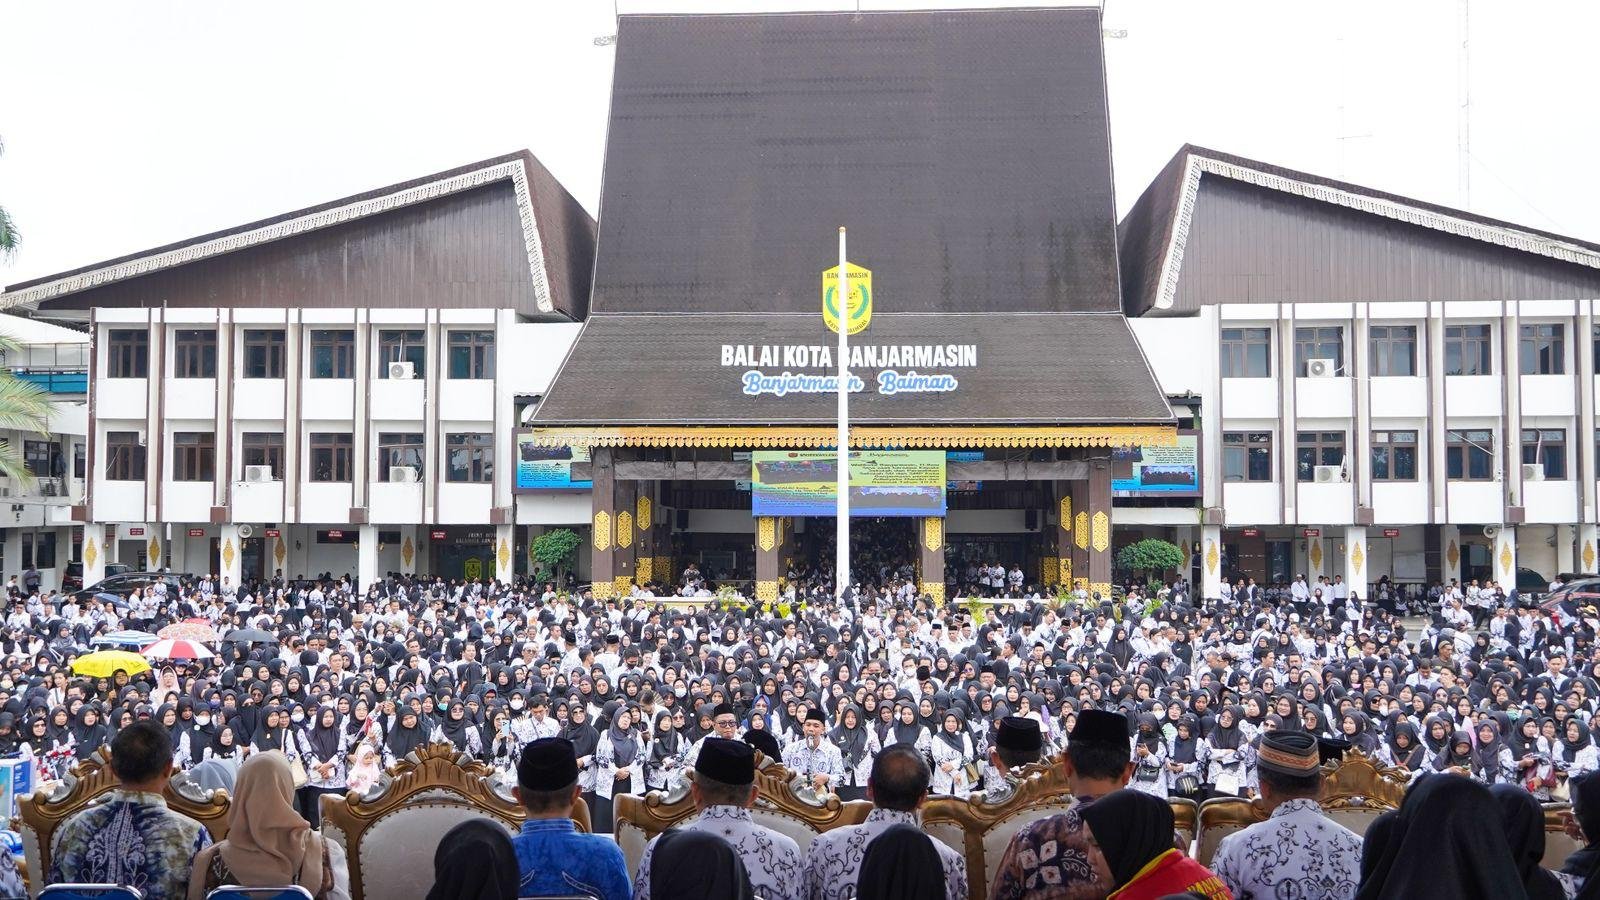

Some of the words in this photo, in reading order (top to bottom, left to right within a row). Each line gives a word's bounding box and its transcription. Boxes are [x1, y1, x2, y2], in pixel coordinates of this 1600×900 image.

[721, 345, 779, 366] BALAI
[783, 345, 832, 367] KOTA
[742, 370, 864, 396] Banjarman
[878, 370, 958, 395] Baiman
